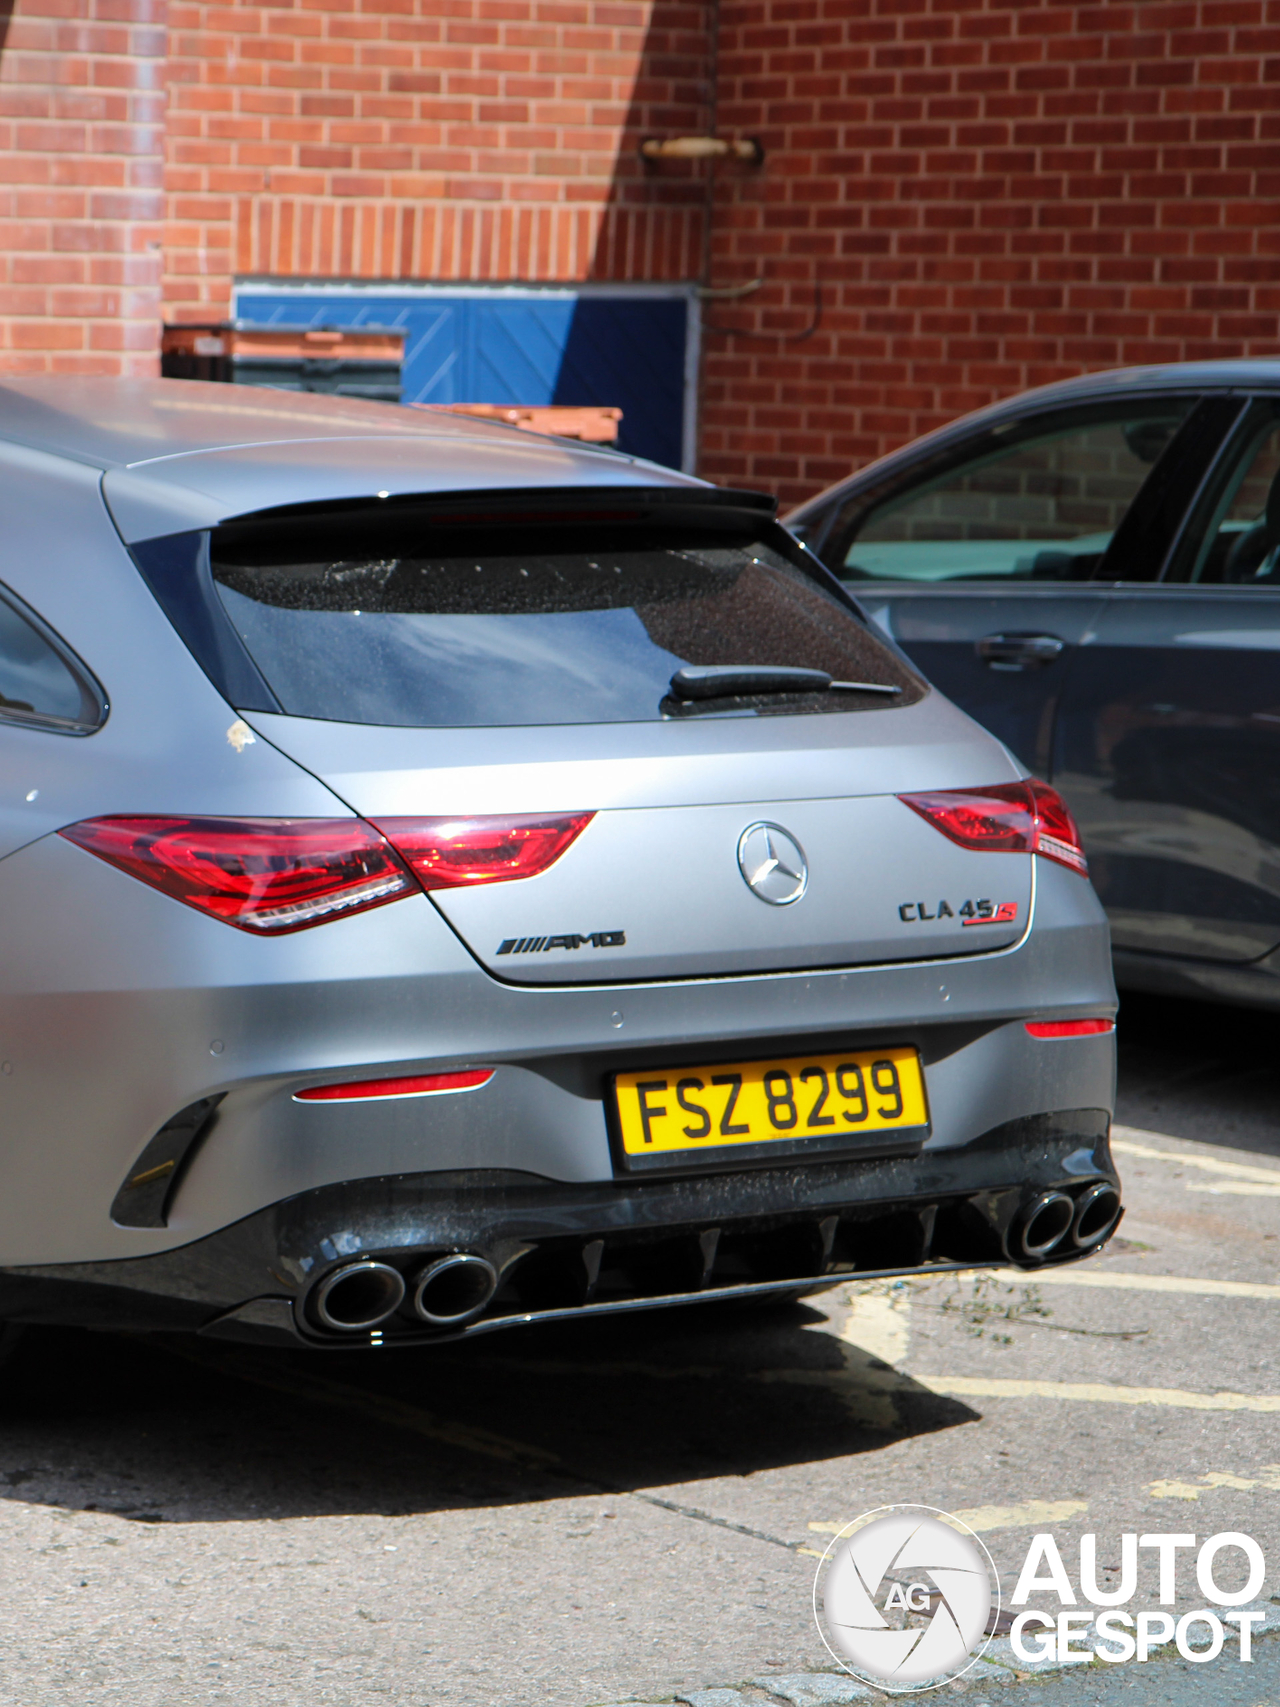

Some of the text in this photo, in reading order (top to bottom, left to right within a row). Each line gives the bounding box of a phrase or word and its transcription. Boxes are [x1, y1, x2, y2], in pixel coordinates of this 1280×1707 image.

[899, 900, 953, 922] CLA
[959, 899, 993, 918] 45
[636, 1059, 904, 1144] FSZ 8299
